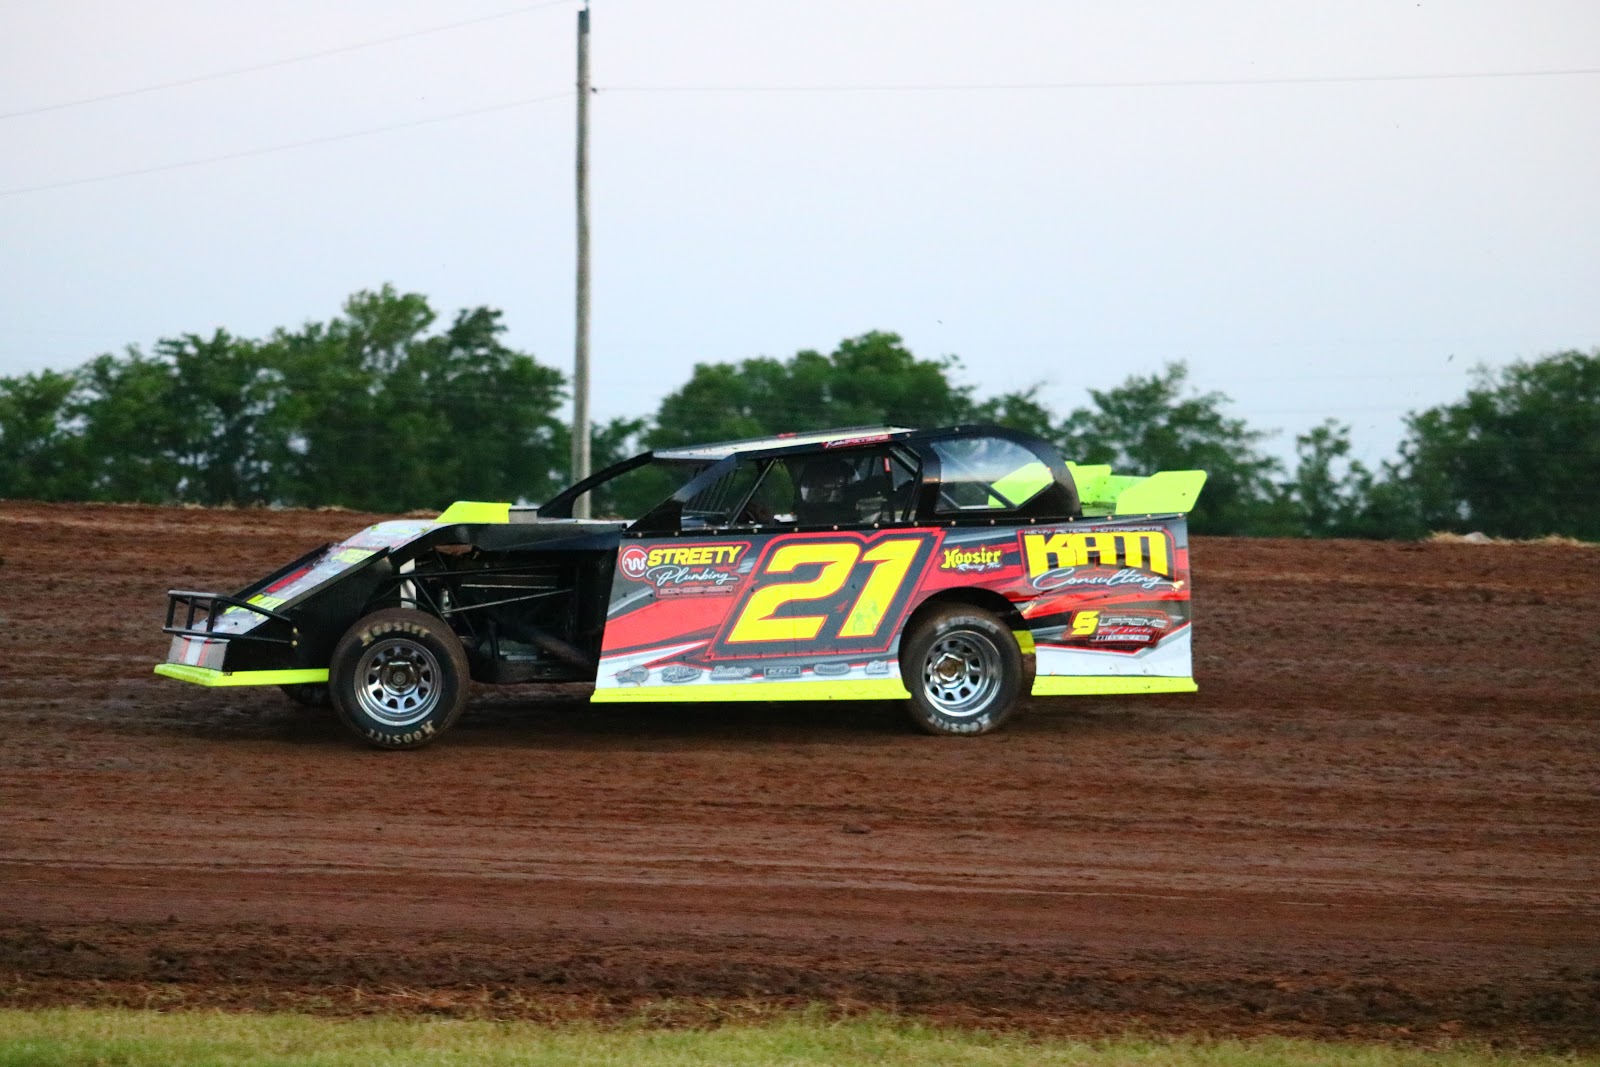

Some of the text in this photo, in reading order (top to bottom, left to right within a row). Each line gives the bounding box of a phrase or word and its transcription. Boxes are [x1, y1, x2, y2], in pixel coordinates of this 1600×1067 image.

[647, 546, 742, 566] STREETY
[941, 547, 1001, 568] Hoosier
[646, 565, 738, 586] Plumbing
[1032, 567, 1175, 590] Consulting
[725, 538, 925, 644] 21
